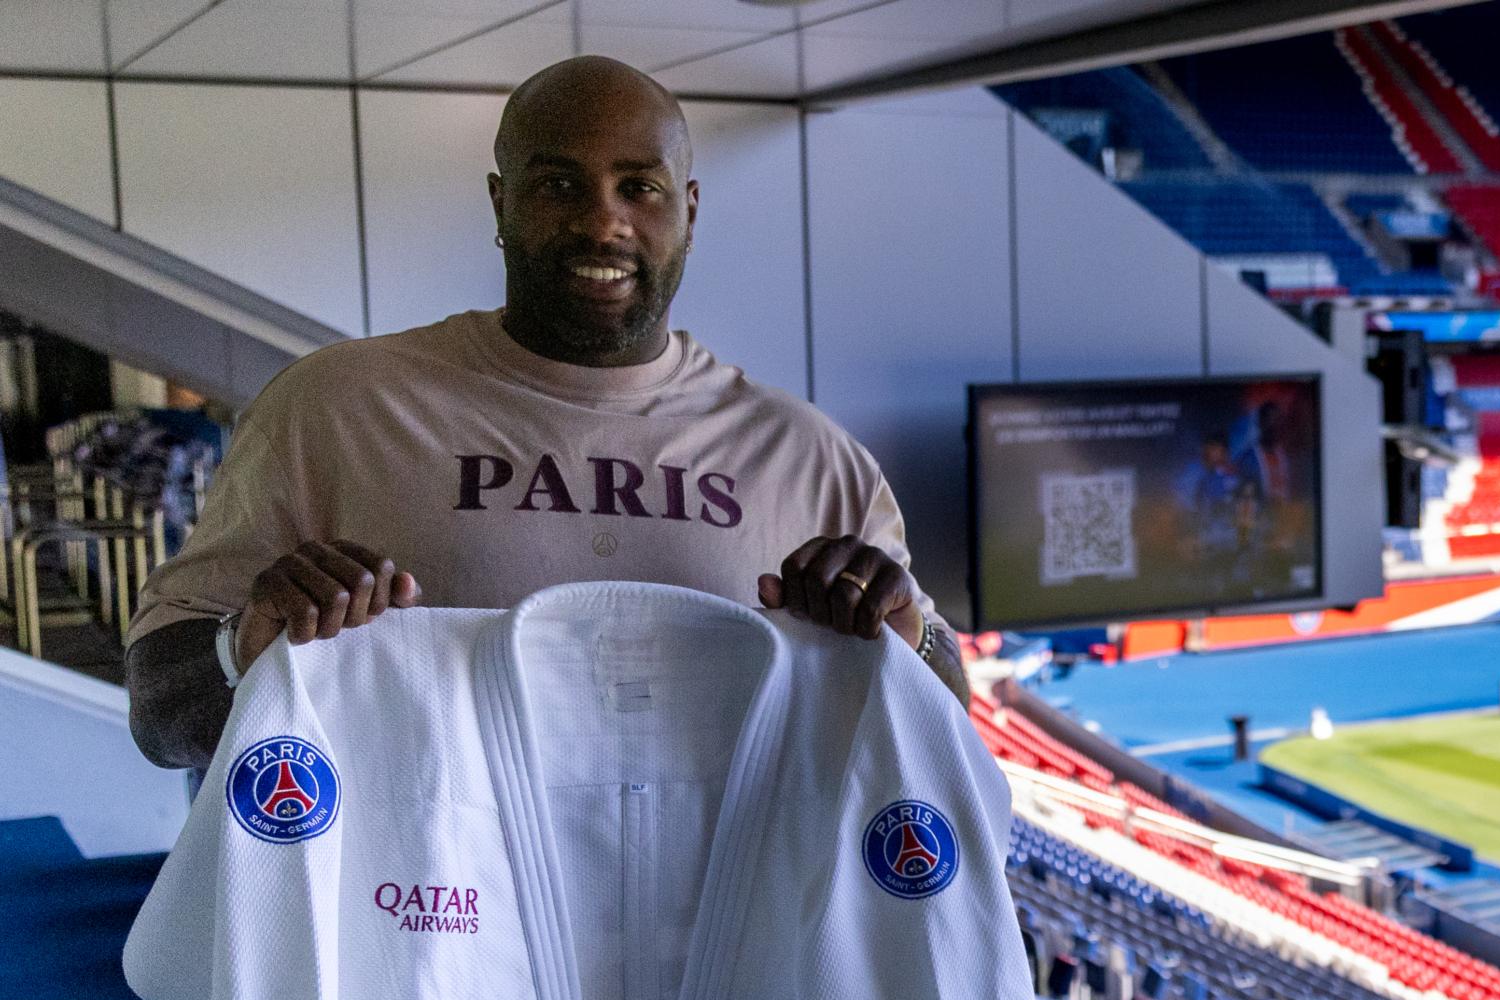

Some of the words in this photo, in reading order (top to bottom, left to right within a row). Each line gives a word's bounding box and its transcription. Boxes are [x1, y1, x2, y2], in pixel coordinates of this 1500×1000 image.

[453, 453, 743, 529] PARIS
[246, 743, 316, 773] PARIS
[875, 807, 933, 836] PARIS
[374, 882, 479, 917] QATAR
[399, 914, 479, 934] AIRWAYS
